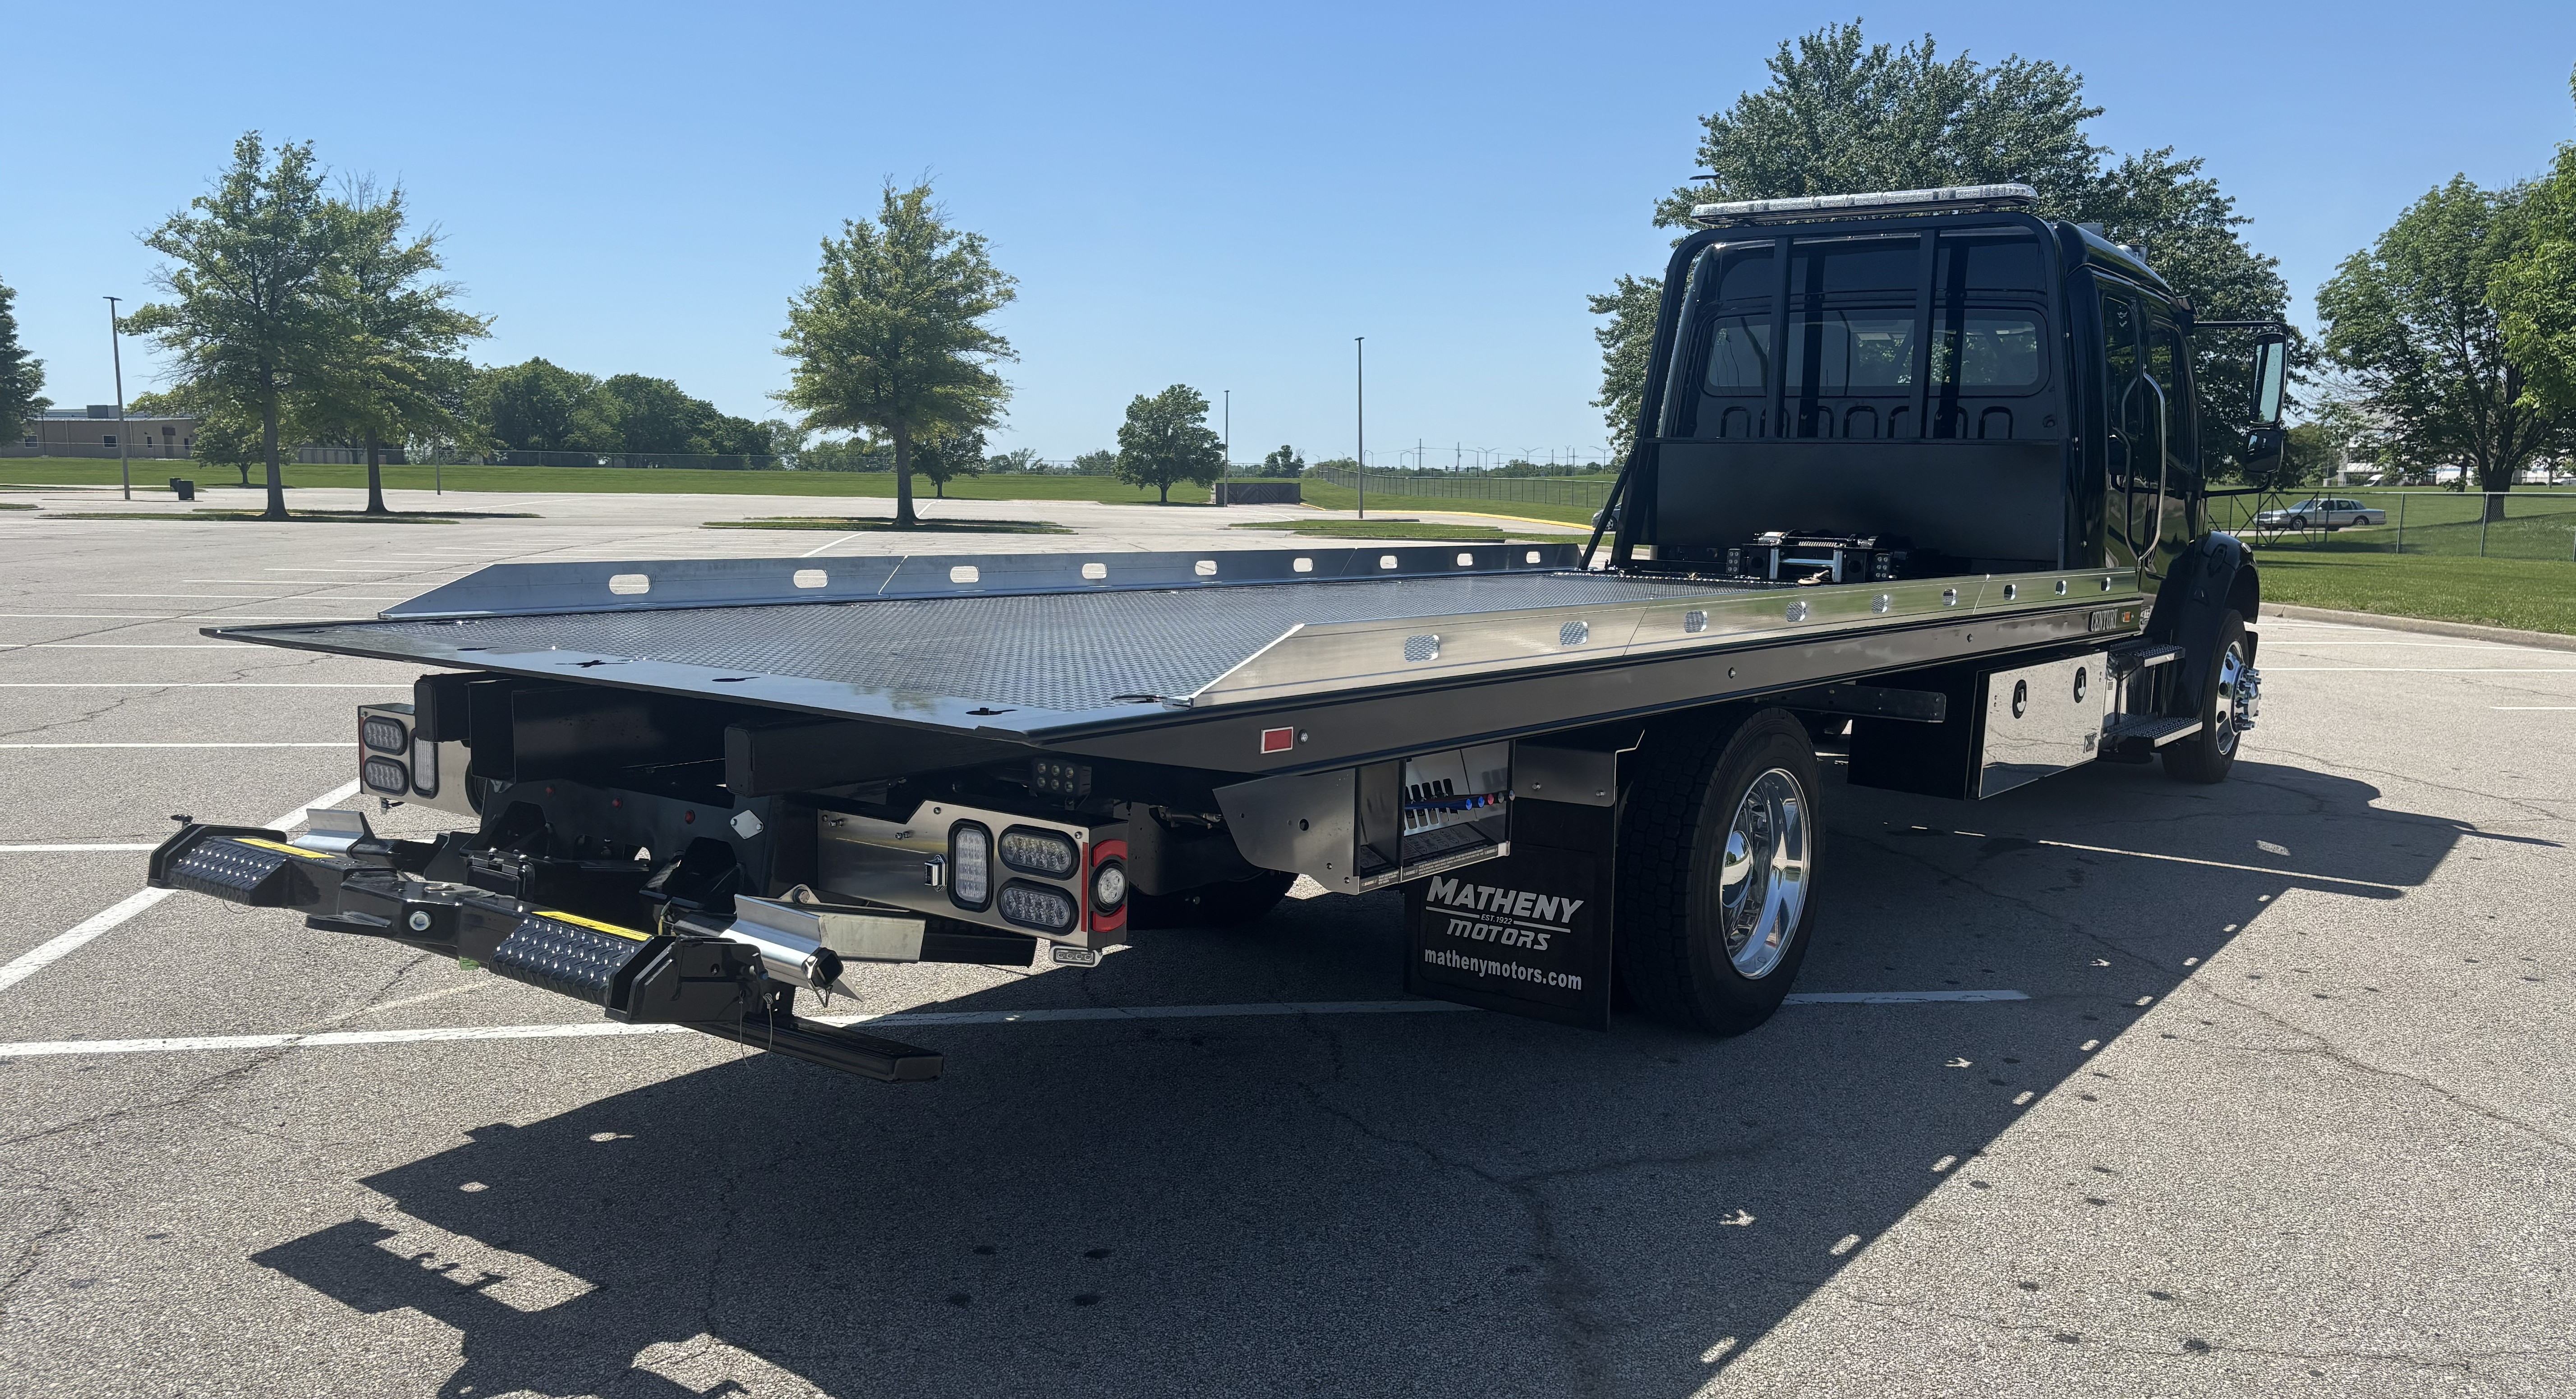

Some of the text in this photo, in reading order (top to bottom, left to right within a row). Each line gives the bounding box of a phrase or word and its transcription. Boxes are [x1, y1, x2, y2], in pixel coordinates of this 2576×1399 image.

[2091, 608, 2118, 632] CENTURY
[1426, 875, 1584, 923] MATHENY
[1446, 918, 1551, 951] MOTORS
[1425, 948, 1582, 990] mathenymotors.com
